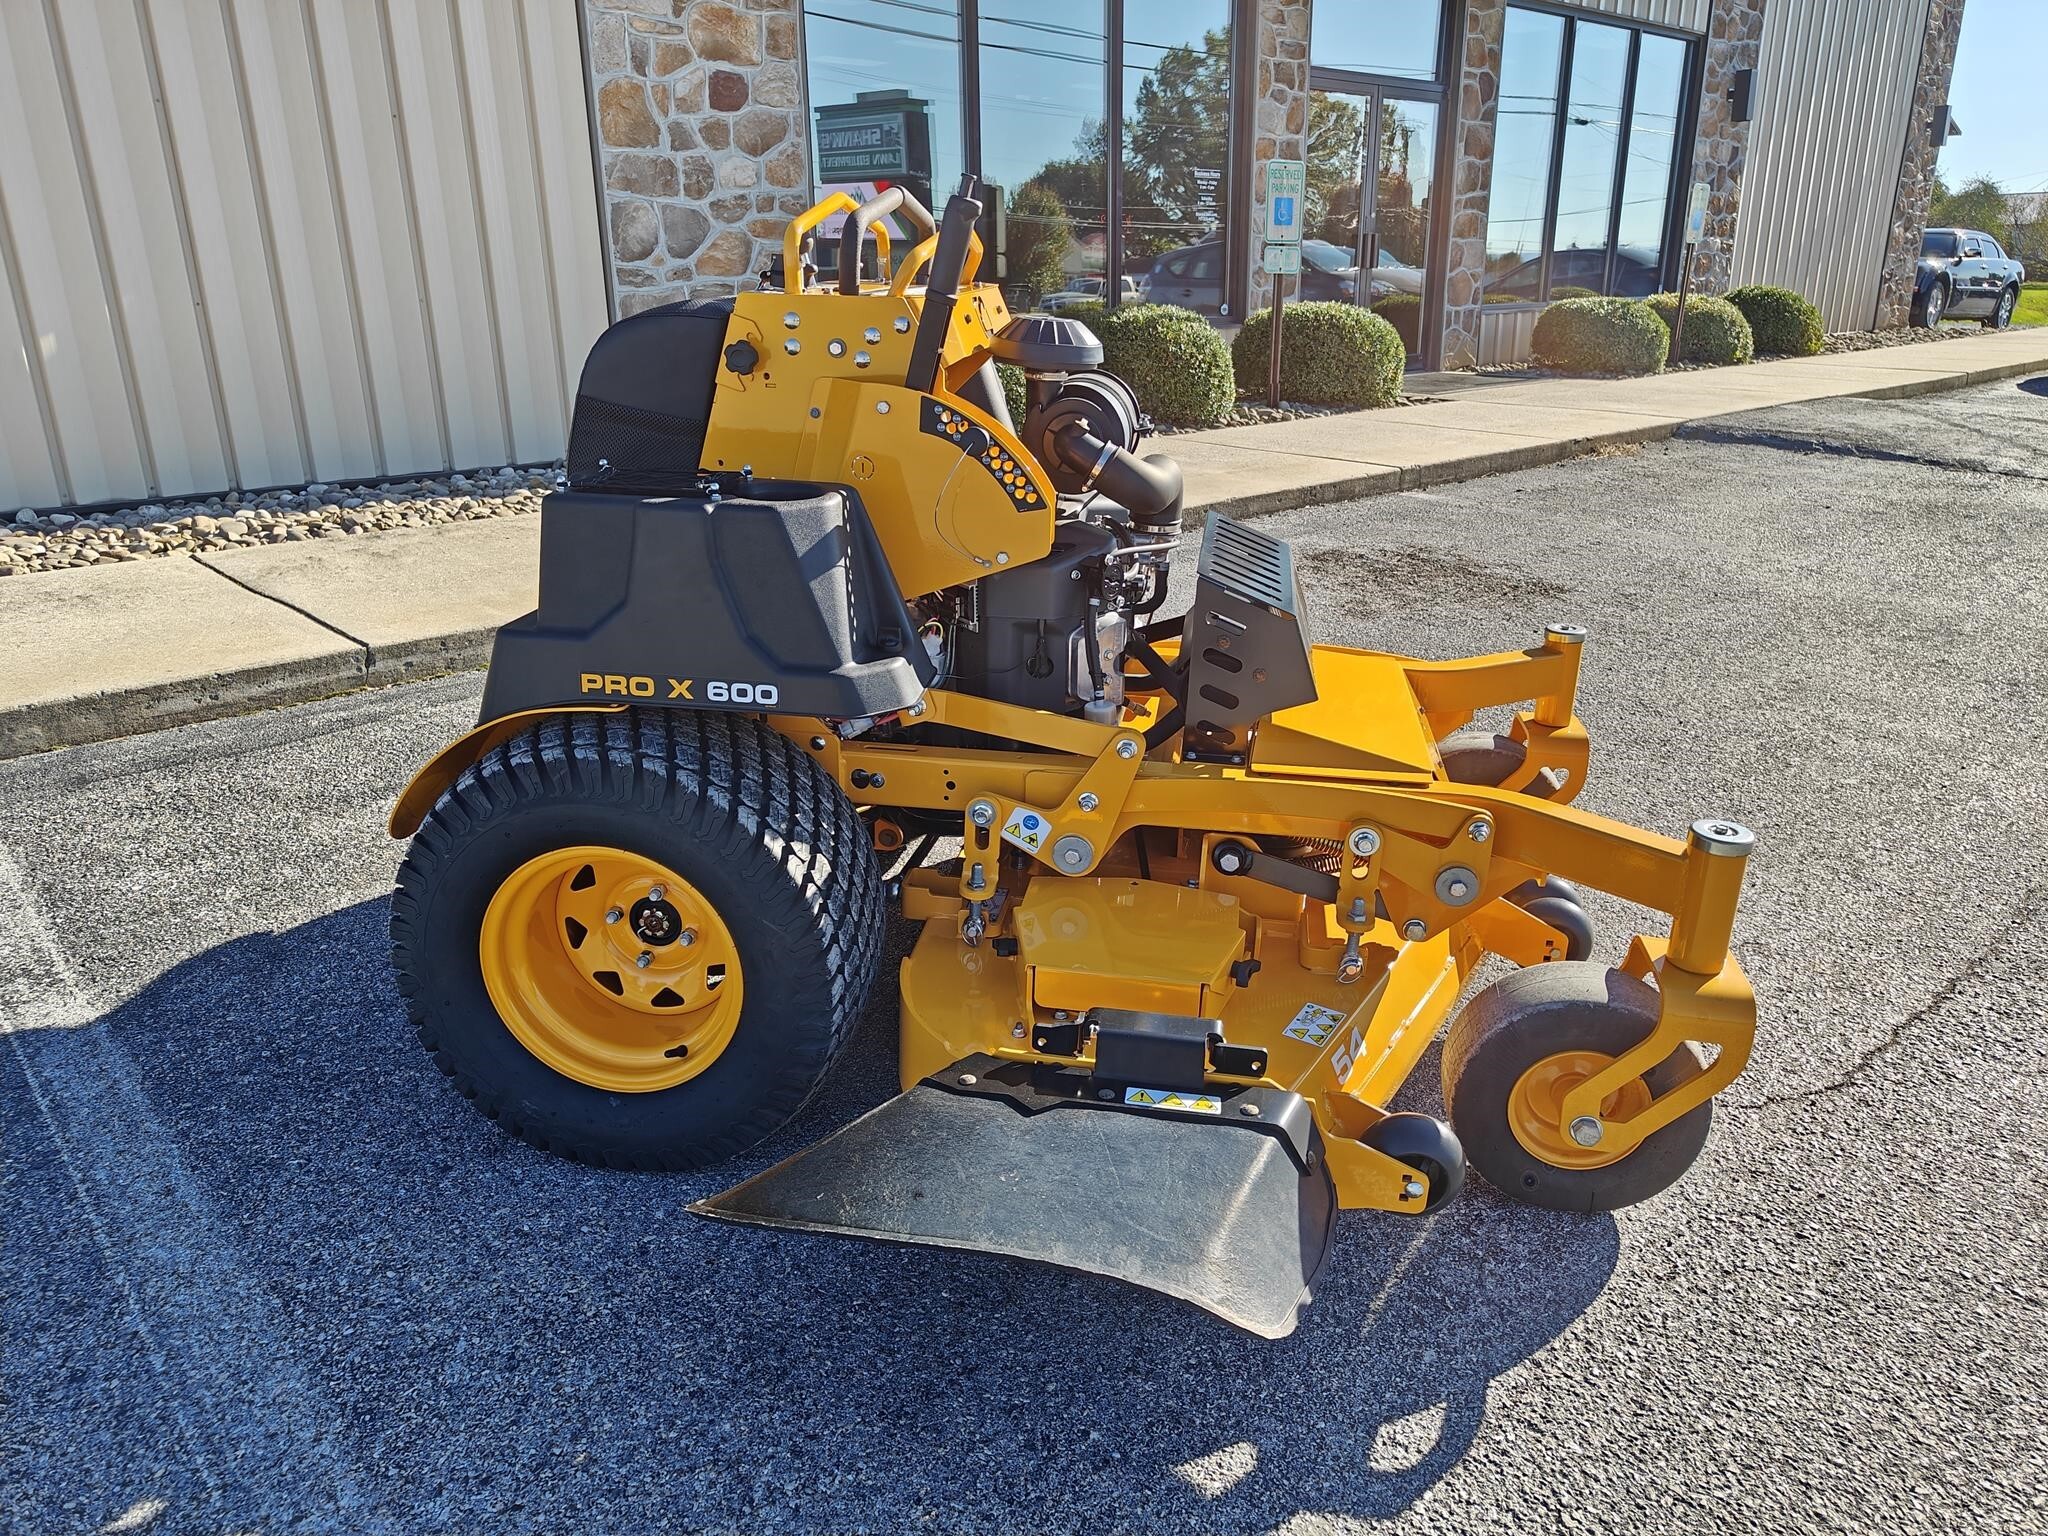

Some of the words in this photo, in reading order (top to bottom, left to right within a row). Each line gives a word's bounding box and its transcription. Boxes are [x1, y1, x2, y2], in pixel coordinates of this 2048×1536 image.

[1270, 168, 1302, 180] RESERVED
[1271, 183, 1299, 194] PARKING
[581, 673, 655, 697] PRO
[667, 678, 694, 700] X
[706, 681, 779, 705] 600
[1331, 1026, 1367, 1085] 54
